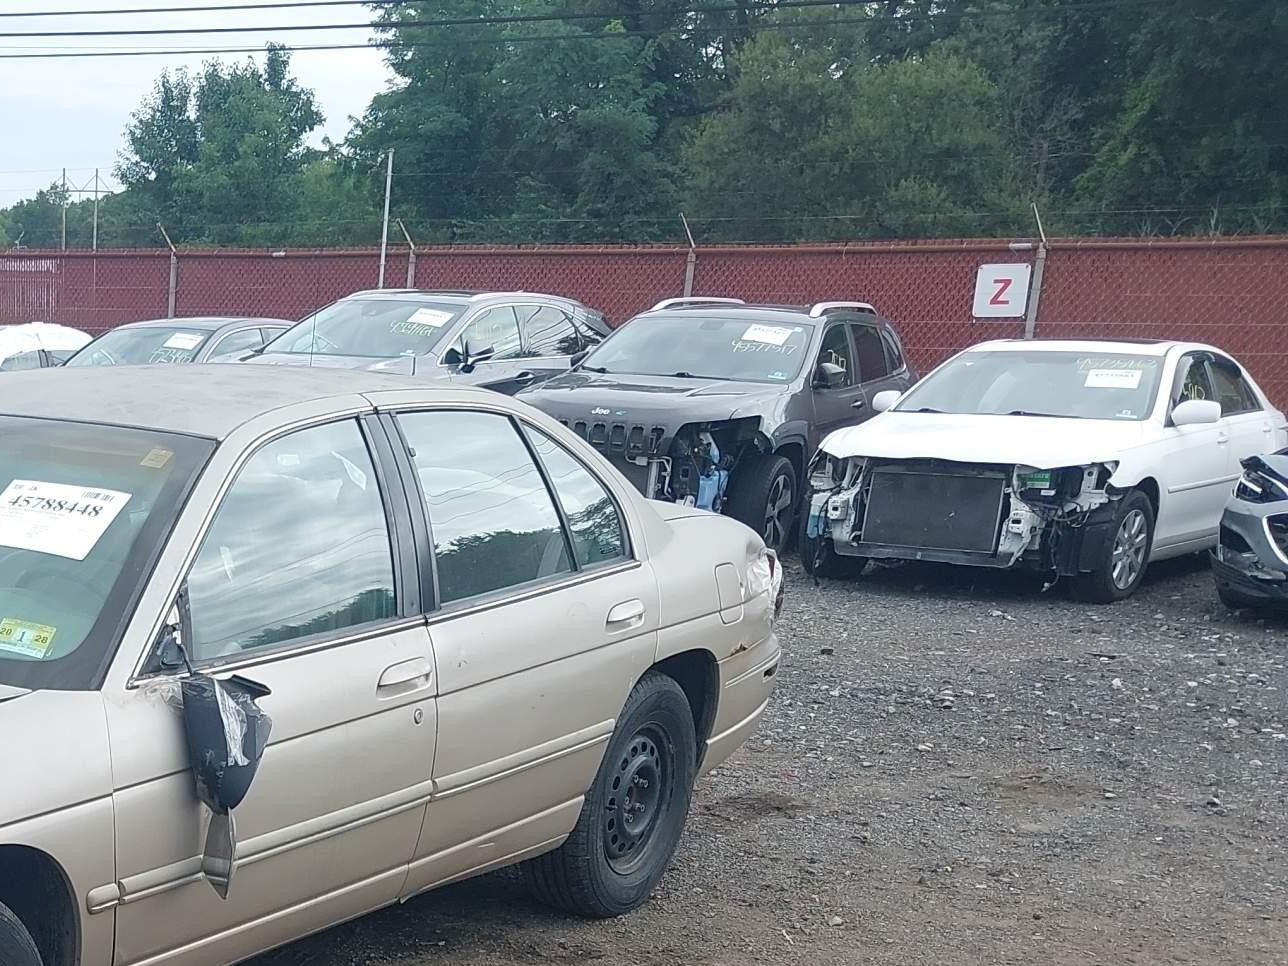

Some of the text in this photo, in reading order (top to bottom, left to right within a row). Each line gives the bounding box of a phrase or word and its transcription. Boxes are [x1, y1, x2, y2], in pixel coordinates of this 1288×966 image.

[989, 279, 1013, 305] Z
[8, 495, 103, 517] 45788448
[0, 627, 12, 636] 20
[16, 631, 26, 642] 1
